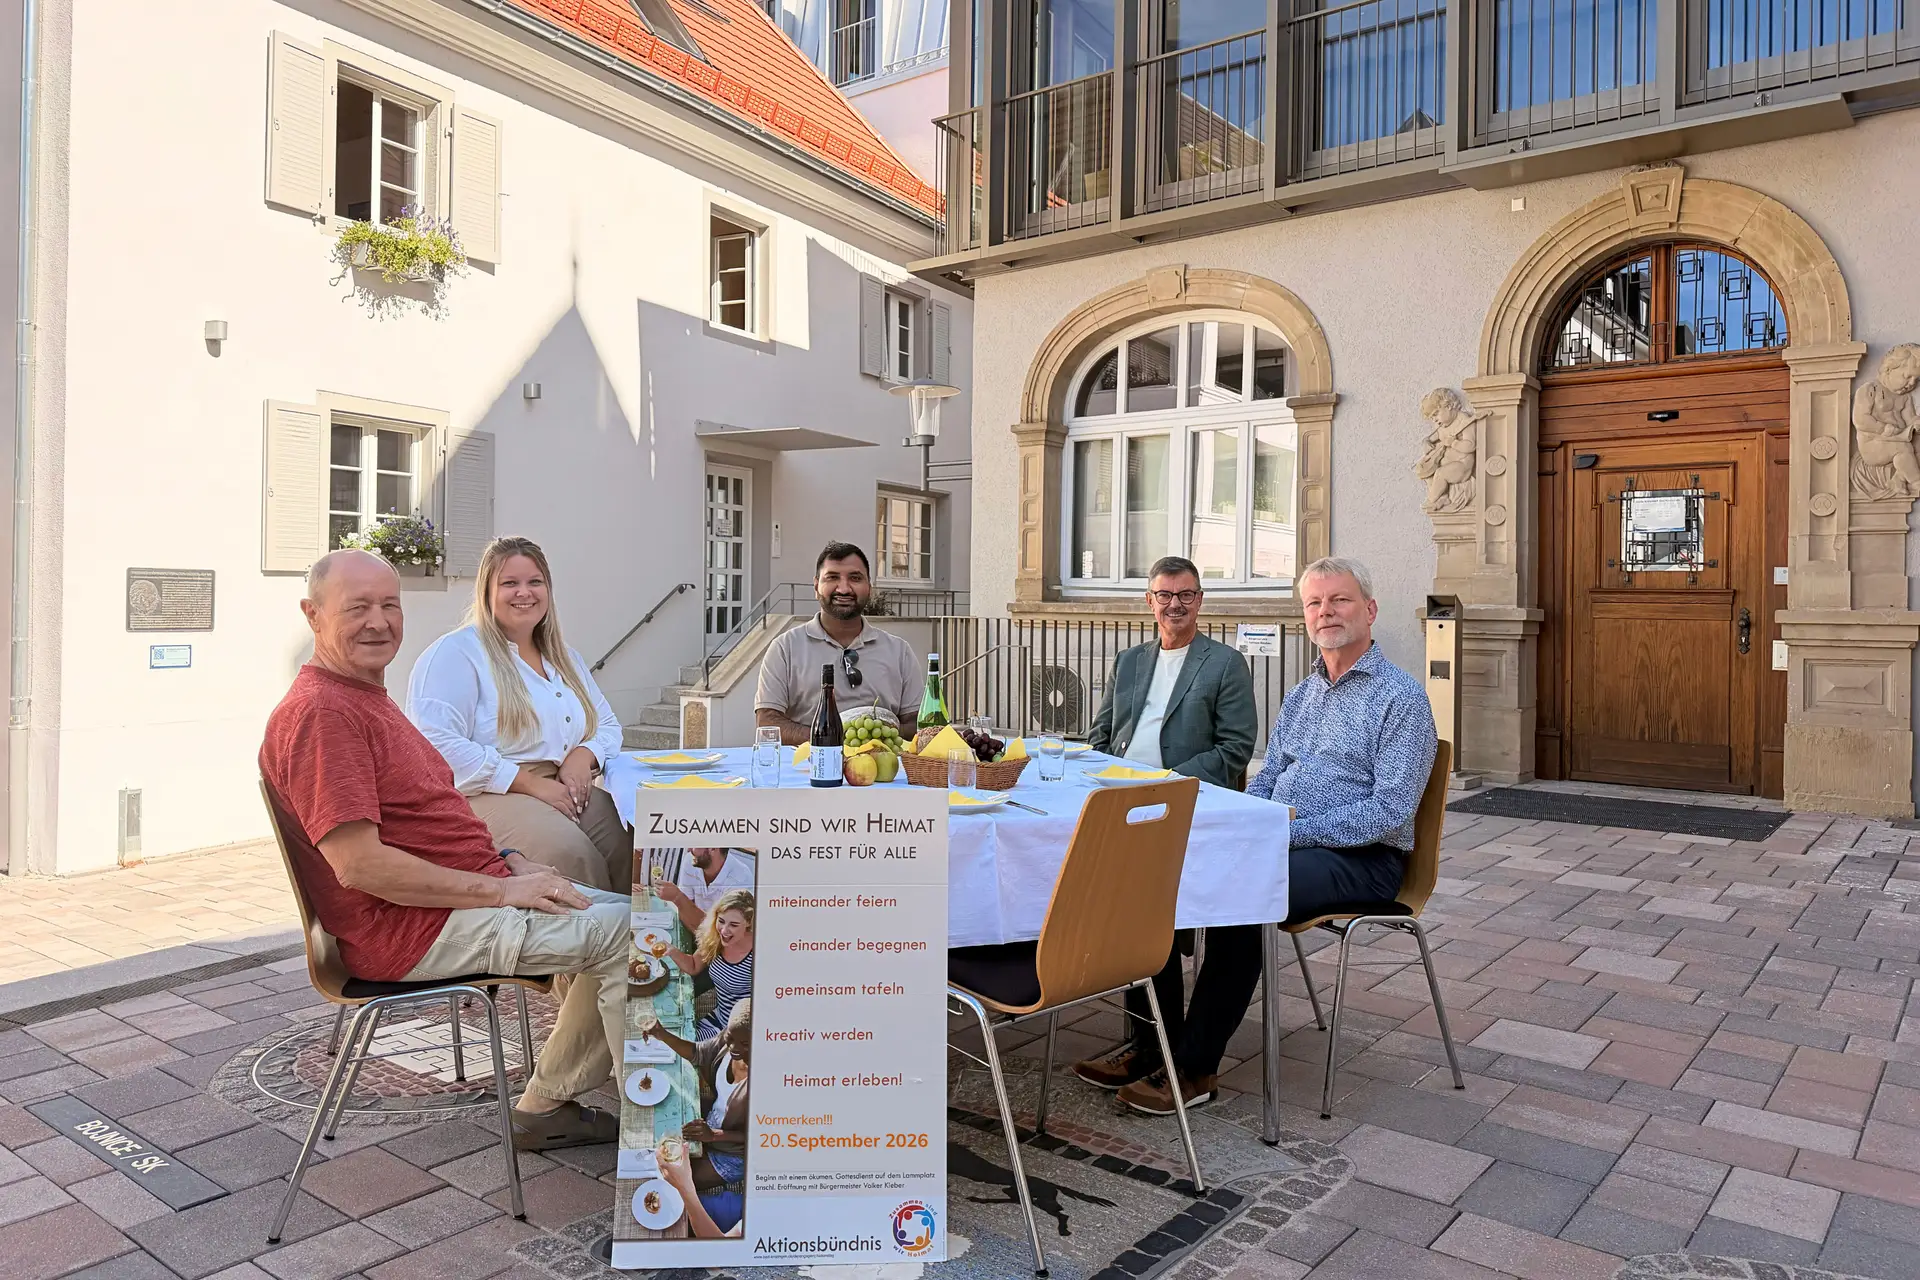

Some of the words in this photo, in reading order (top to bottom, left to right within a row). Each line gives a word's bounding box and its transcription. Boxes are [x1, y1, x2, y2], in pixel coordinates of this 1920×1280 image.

[771, 846, 801, 859] DAS
[809, 846, 842, 859] FEST
[849, 843, 877, 859] FÜR
[884, 846, 916, 859] ALLE
[769, 895, 851, 908] miteinander
[856, 895, 897, 907] feiern
[789, 938, 851, 951] einander
[857, 938, 927, 953] begegnen
[775, 983, 855, 999] gemeinsam
[862, 982, 904, 996] tafeln
[766, 1028, 815, 1041] kreativ
[821, 1028, 873, 1040] werden
[783, 1074, 836, 1087] Heimat
[841, 1073, 903, 1086] erleben!
[756, 1114, 833, 1126] Vormerken!!!
[73, 1120, 142, 1156] BOJNICE
[131, 1156, 170, 1174] SK
[759, 1134, 785, 1148] 20.
[787, 1134, 880, 1151] September
[885, 1133, 929, 1148] 2026
[755, 1174, 776, 1182] Beginn
[902, 1172, 935, 1180] Lammplatz
[777, 1183, 806, 1191] Eröffnung
[888, 1199, 923, 1219] Zusammen
[925, 1203, 938, 1216] sind
[754, 1235, 881, 1253] Aktionsbündnis
[893, 1245, 905, 1255] wir
[907, 1244, 934, 1257] Heimat
